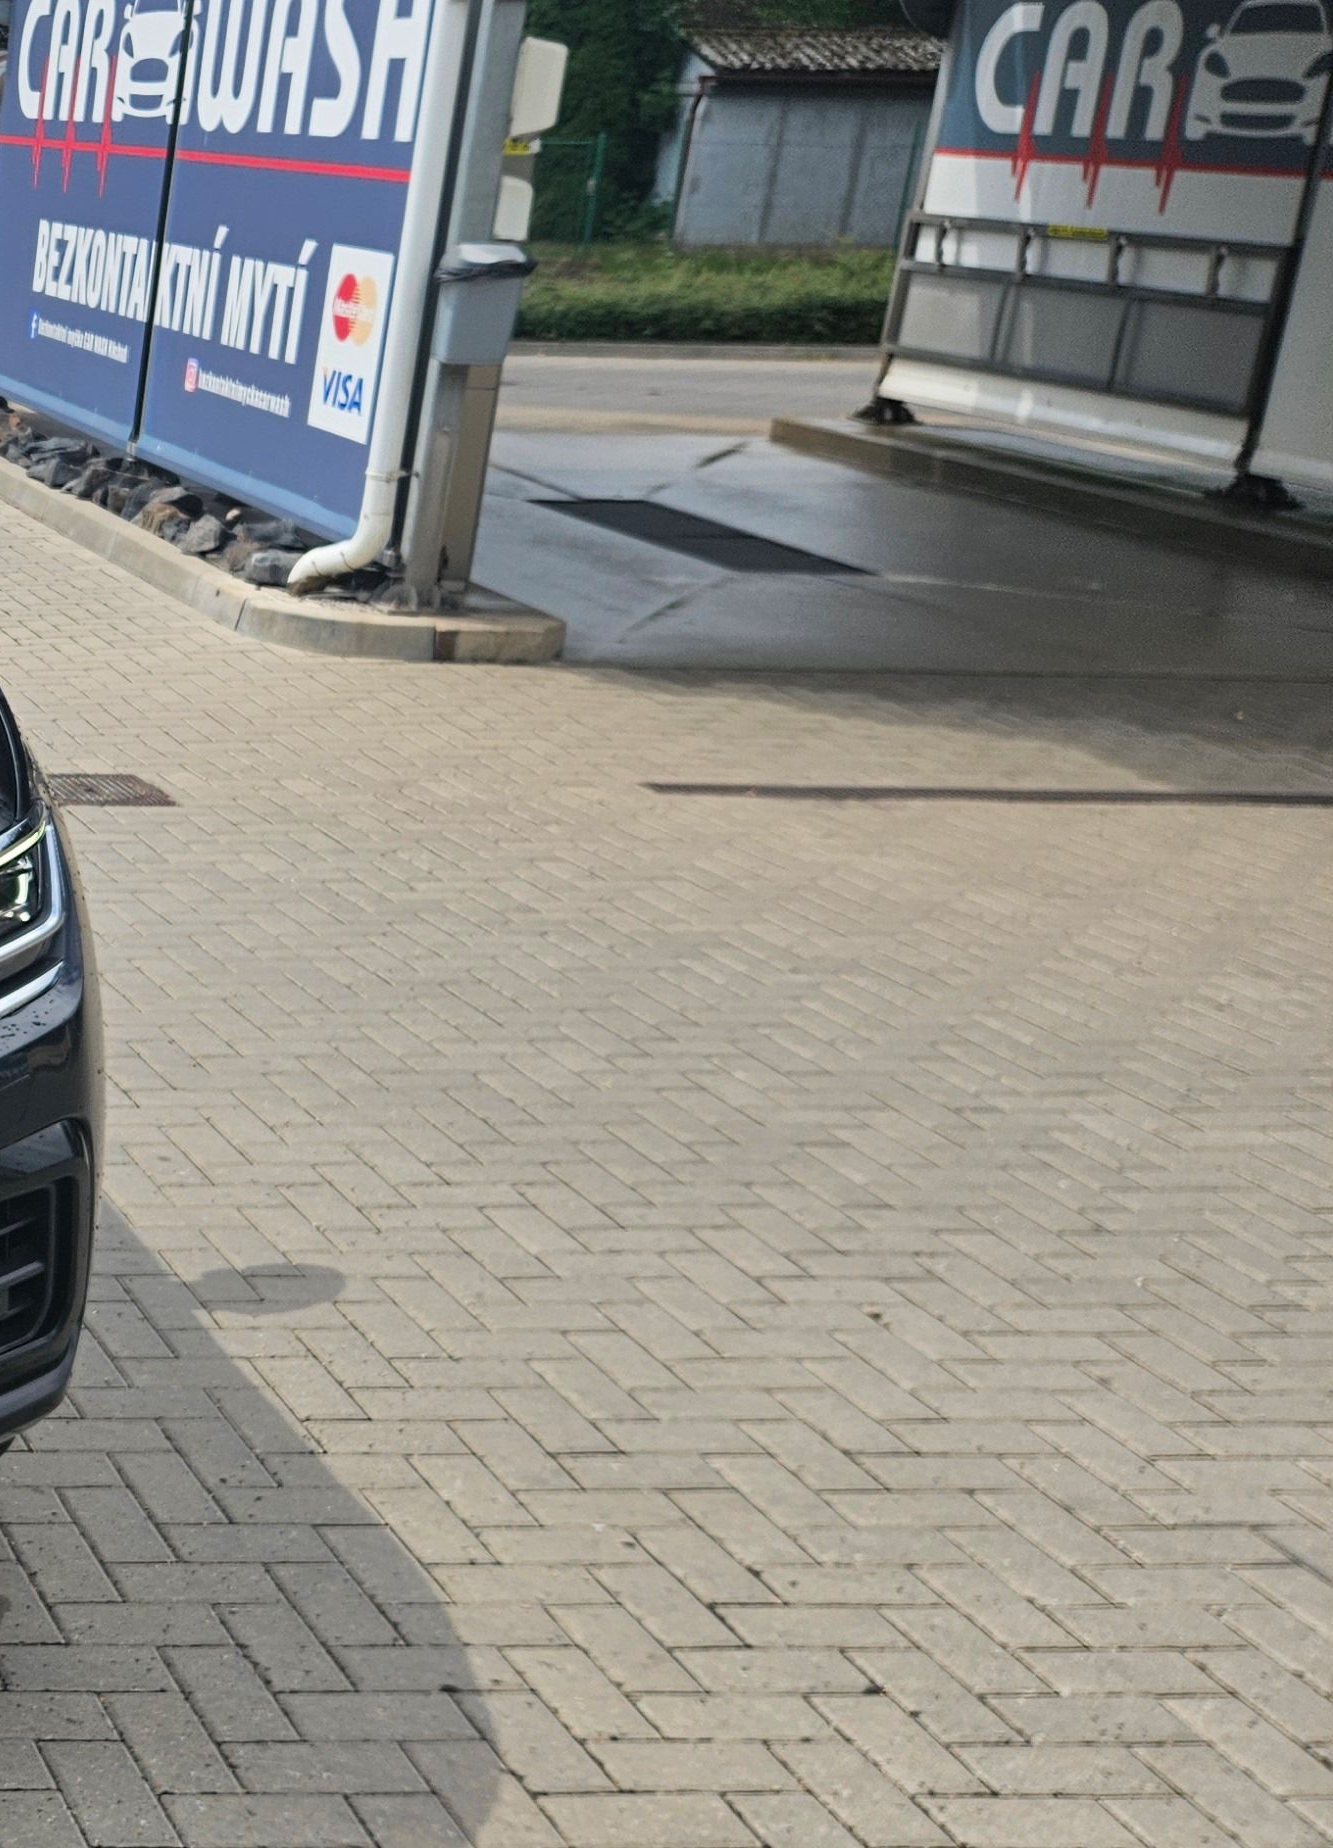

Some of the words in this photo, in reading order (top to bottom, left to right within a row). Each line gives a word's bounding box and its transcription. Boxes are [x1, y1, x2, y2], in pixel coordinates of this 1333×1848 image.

[18, 0, 115, 122] CAR
[197, 0, 432, 142] WASH
[975, 0, 1183, 141] CAR
[32, 218, 229, 340] BEZKONTAKTNÍ
[221, 238, 318, 364] MYTÍ
[322, 366, 364, 415] VISA
